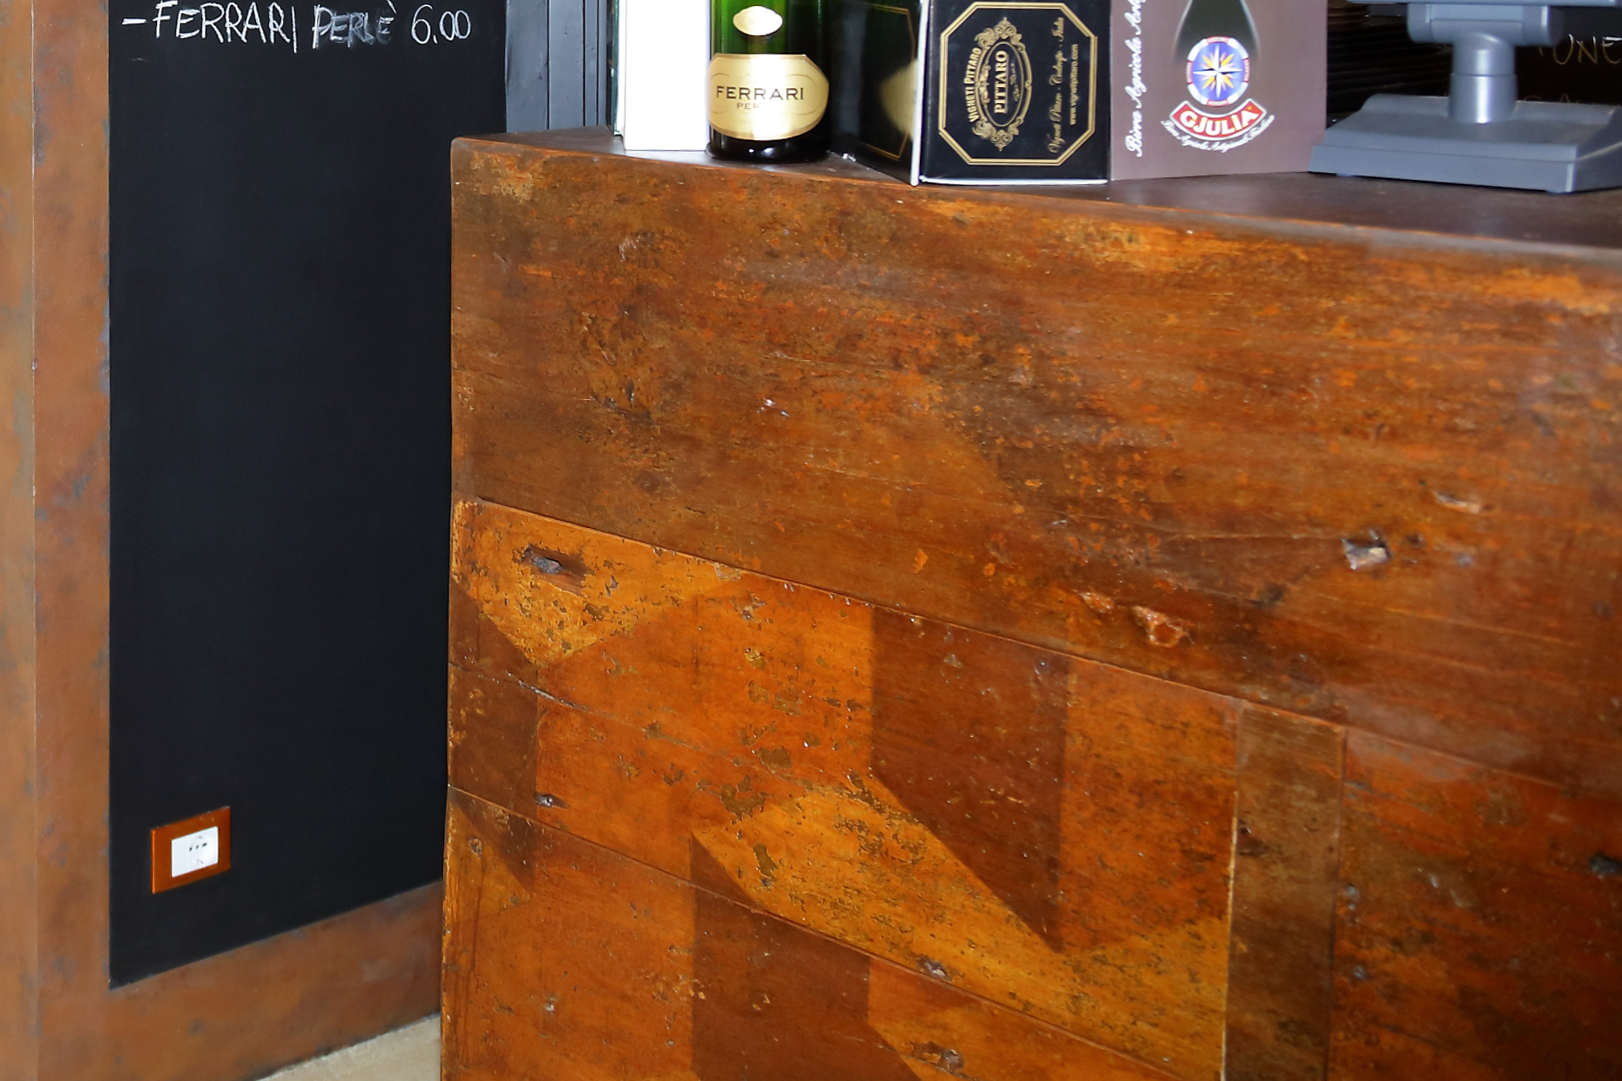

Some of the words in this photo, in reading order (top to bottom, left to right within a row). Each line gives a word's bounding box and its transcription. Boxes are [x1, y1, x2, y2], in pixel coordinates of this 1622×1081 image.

[963, 47, 983, 85] PITTARO
[993, 50, 1009, 115] PITTARO
[715, 85, 805, 101] FERRARI
